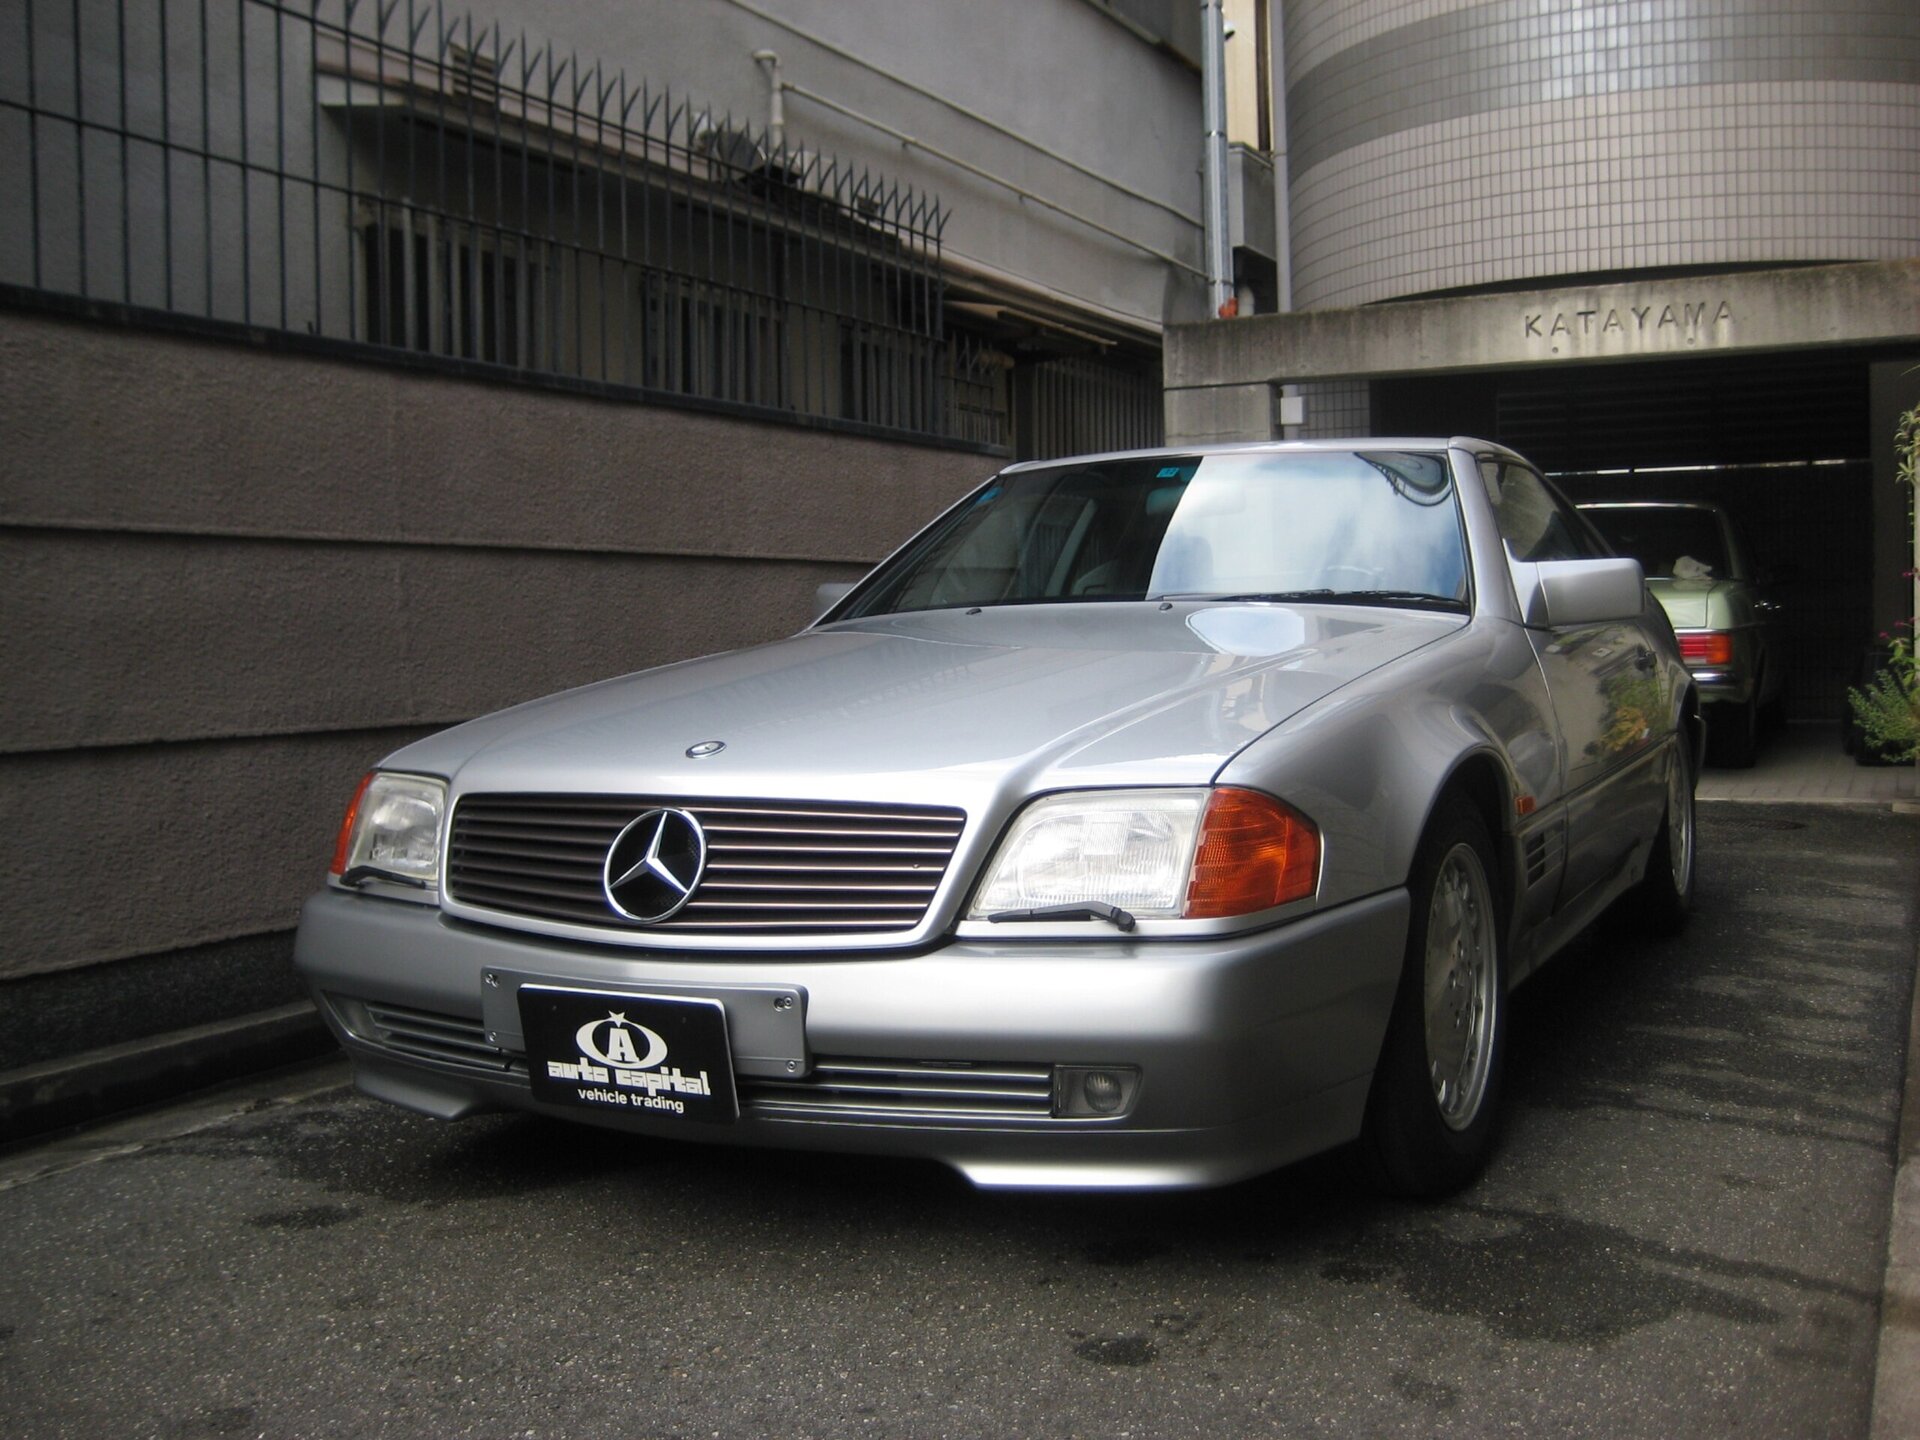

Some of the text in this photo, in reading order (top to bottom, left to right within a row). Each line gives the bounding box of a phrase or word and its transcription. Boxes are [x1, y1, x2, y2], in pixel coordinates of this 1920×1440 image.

[1524, 300, 1736, 338] KATAYAMA
[606, 1027, 640, 1063] A
[547, 1057, 712, 1097] auto capital
[578, 1088, 685, 1114] vehicle trading
